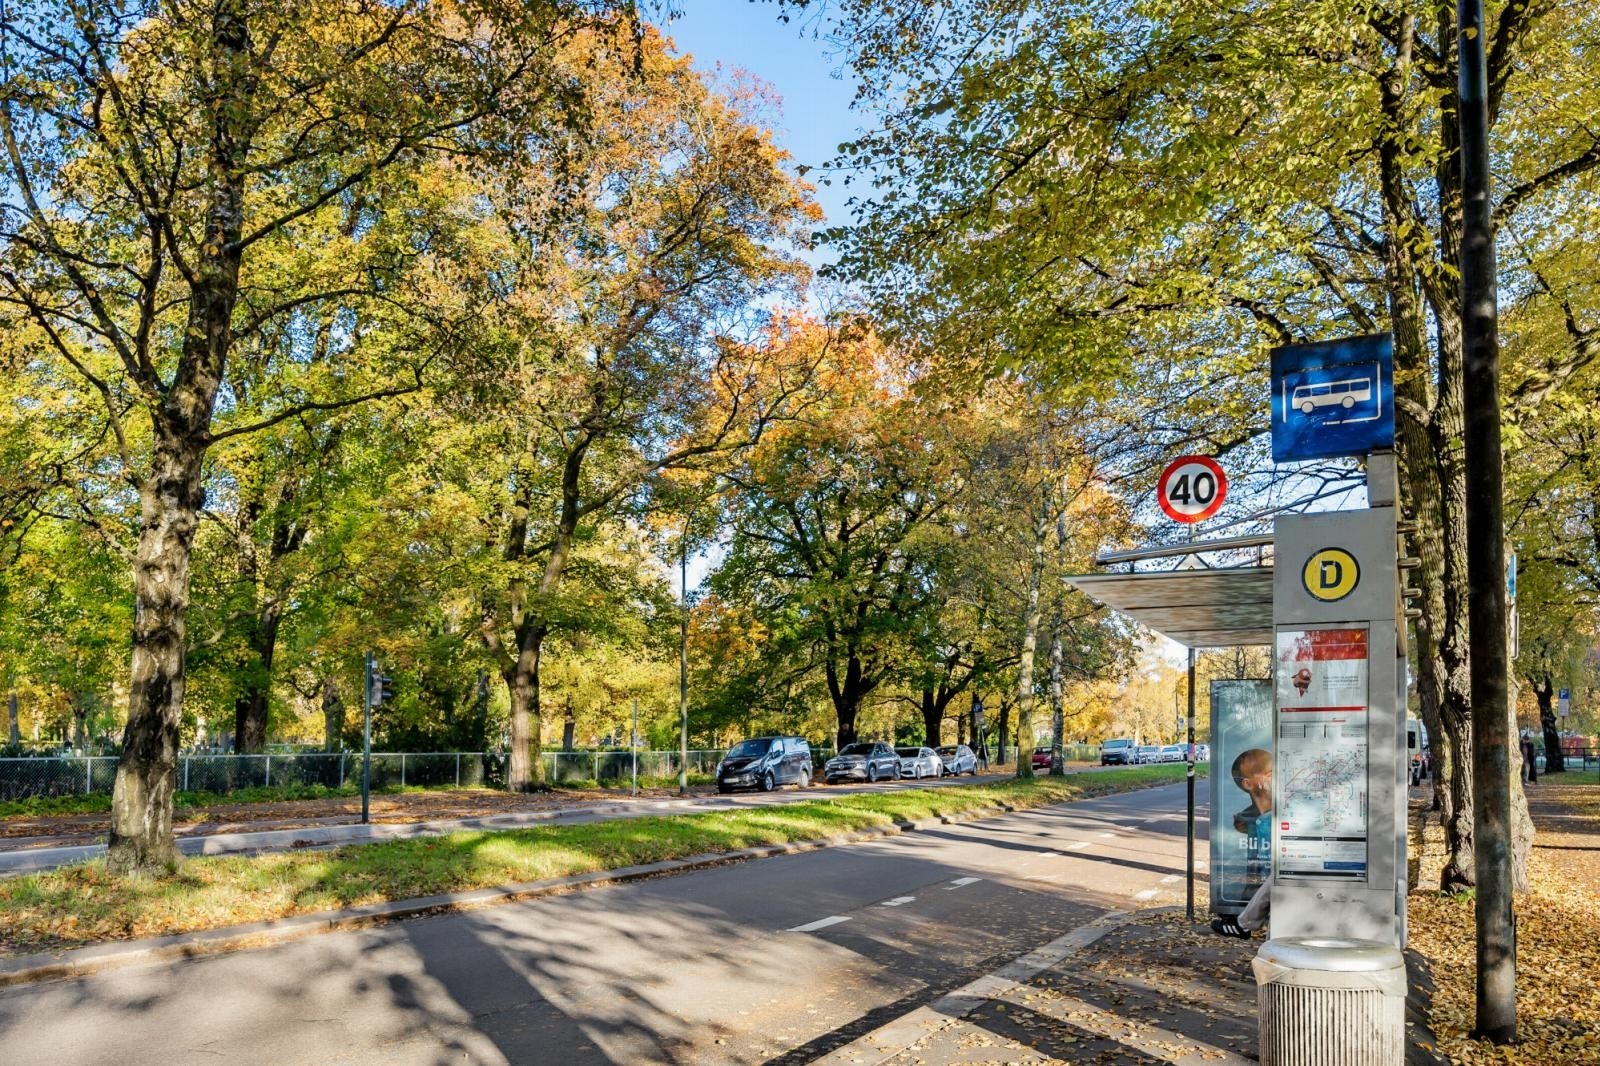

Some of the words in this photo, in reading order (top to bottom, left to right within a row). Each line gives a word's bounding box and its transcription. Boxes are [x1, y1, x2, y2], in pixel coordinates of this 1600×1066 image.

[1169, 472, 1215, 505] 40
[1320, 560, 1343, 589] D
[1238, 837, 1258, 850] Bli
